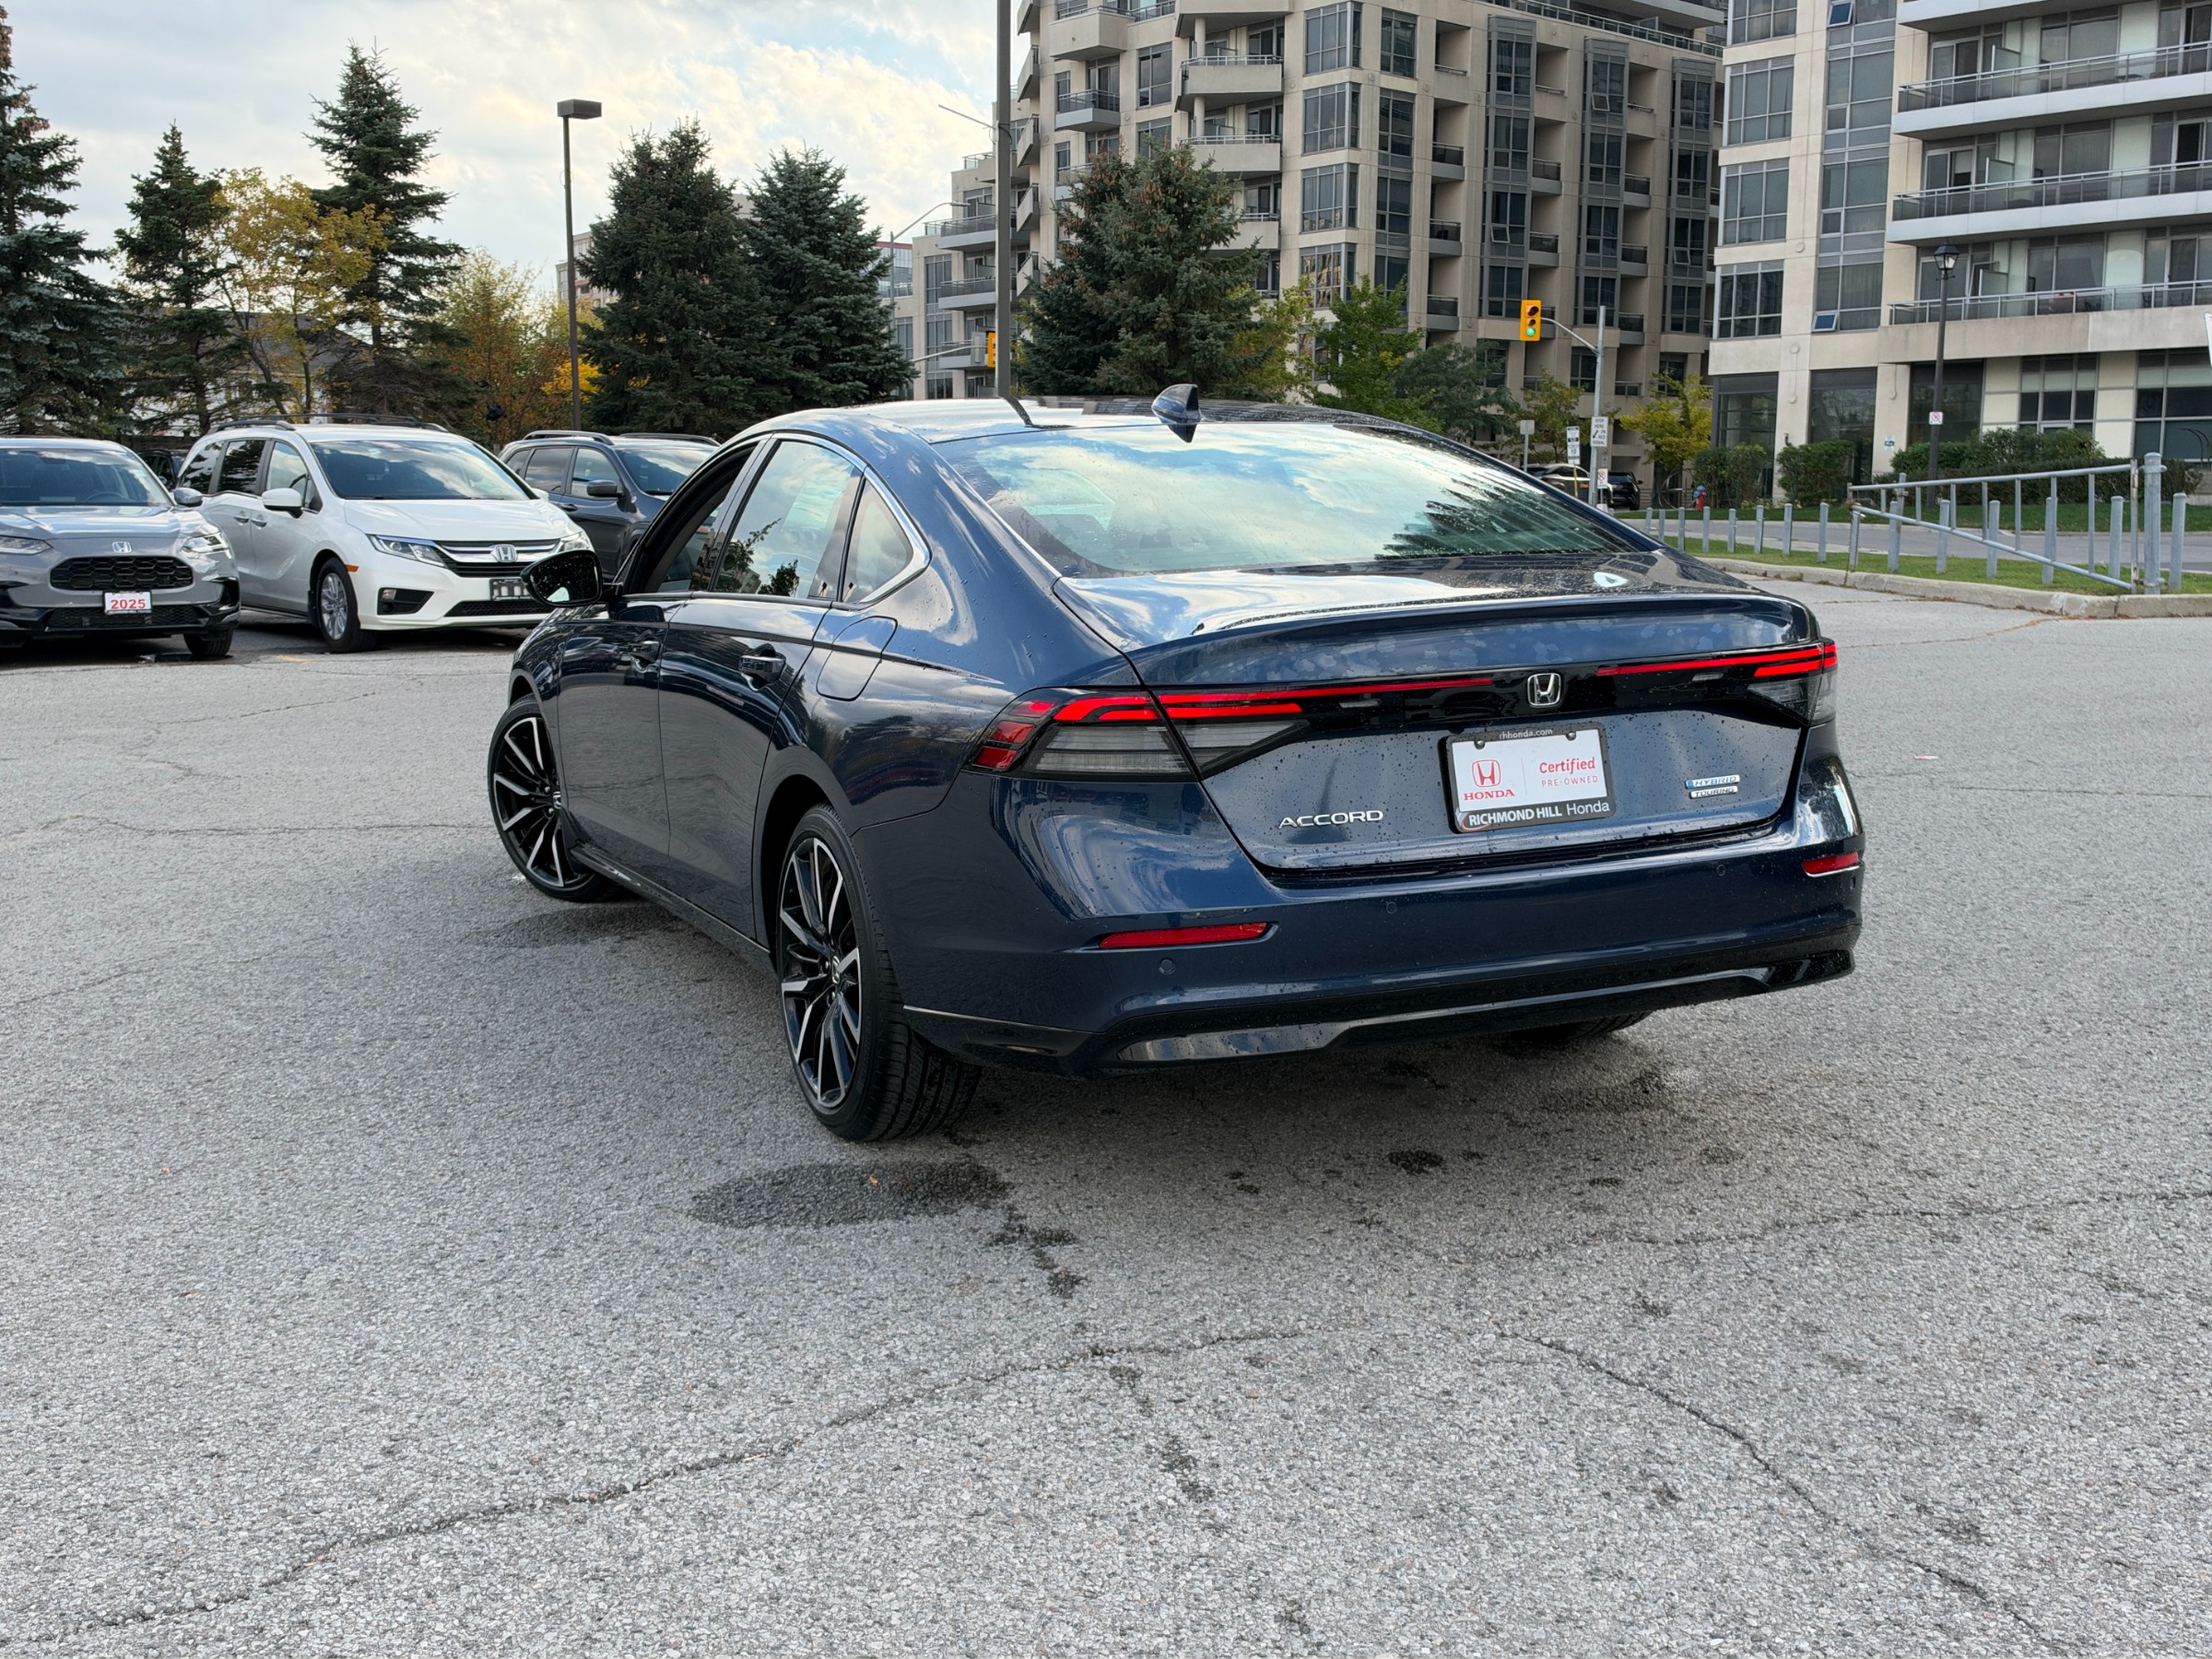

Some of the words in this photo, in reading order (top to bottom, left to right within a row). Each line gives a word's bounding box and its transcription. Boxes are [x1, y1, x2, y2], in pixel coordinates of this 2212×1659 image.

[111, 599, 146, 609] 2025
[1499, 728, 1554, 740] rhhonda.com
[1539, 757, 1595, 775] Certified
[1541, 776, 1598, 787] PRE-OWNED
[1695, 776, 1737, 786] HYBRID
[1464, 789, 1515, 801] HONDA
[1468, 806, 1535, 826] RICHMOND
[1536, 806, 1563, 818] HILL
[1566, 800, 1610, 816] Honda
[1278, 810, 1383, 829] ACCORD
